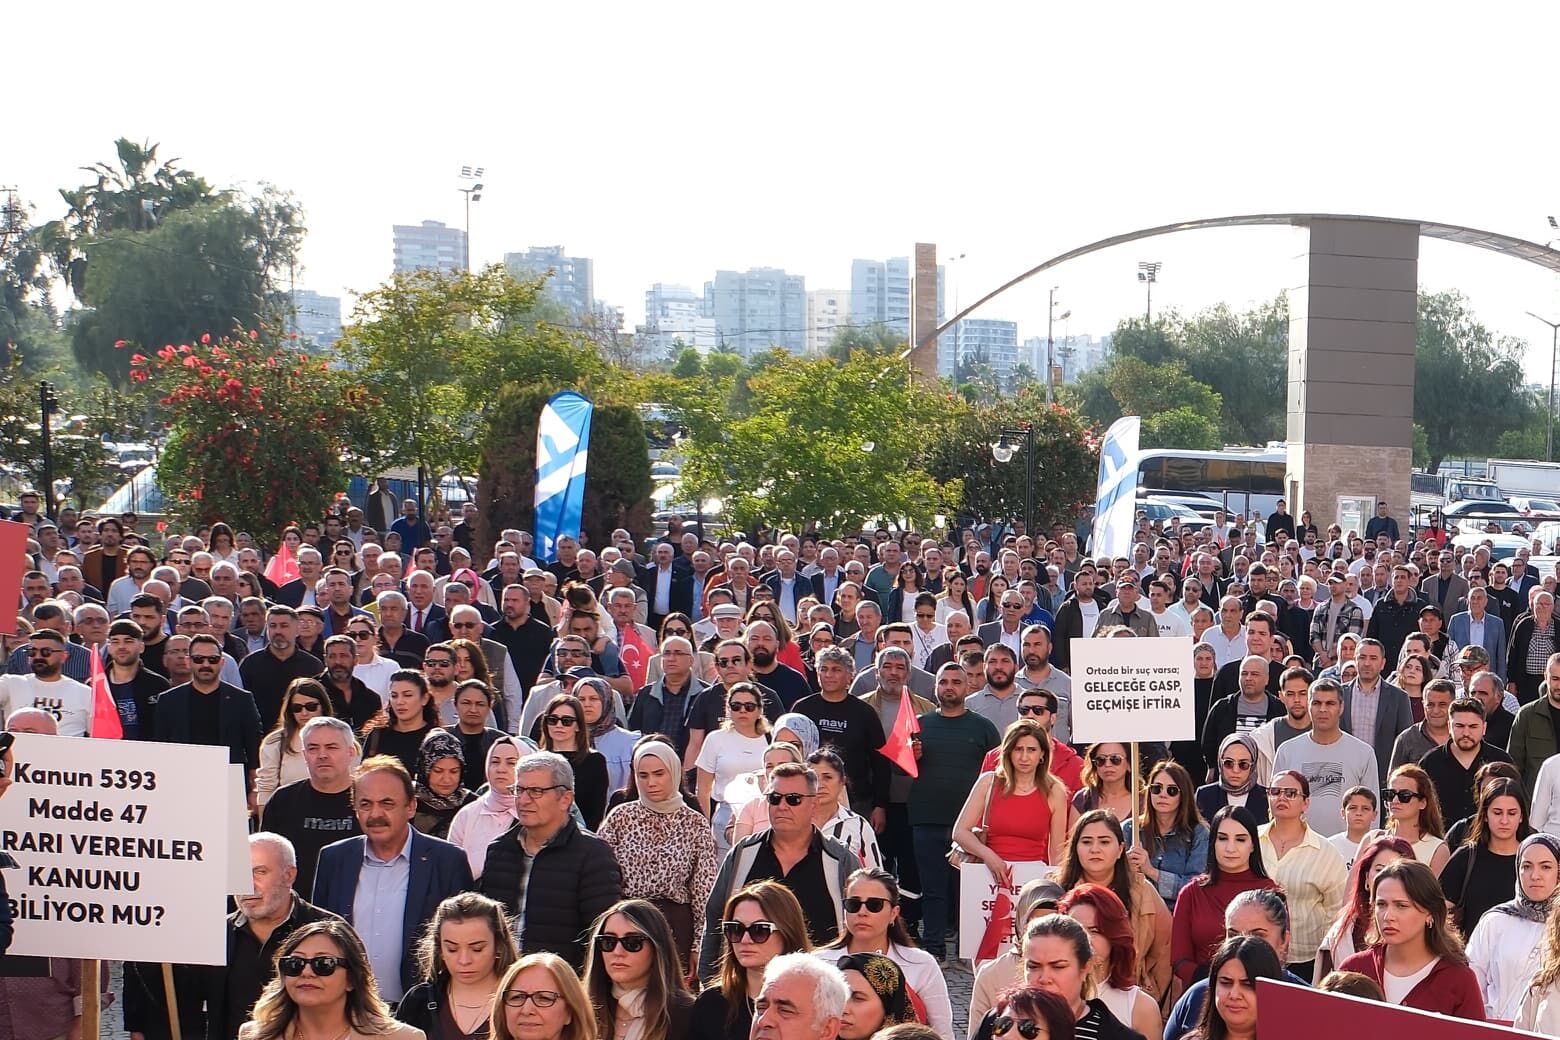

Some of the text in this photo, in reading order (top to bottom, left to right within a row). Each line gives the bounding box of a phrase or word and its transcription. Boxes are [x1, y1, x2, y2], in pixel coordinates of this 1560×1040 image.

[1086, 666, 1119, 675] Ortada
[1121, 666, 1134, 675] bir
[1135, 667, 1151, 676] suç
[1084, 678, 1182, 693] GELECEĞE GASP,
[1086, 695, 1181, 713] GEÇMİŞE İFTİRA
[818, 718, 847, 729] mavi
[15, 762, 157, 791] Kanun 5393
[29, 798, 147, 824] Madde 47
[303, 816, 353, 831] mavi
[2, 830, 204, 861] RARI VERENLER
[29, 866, 140, 891] KANUNU
[8, 893, 165, 926] BİLİYOR MU?
